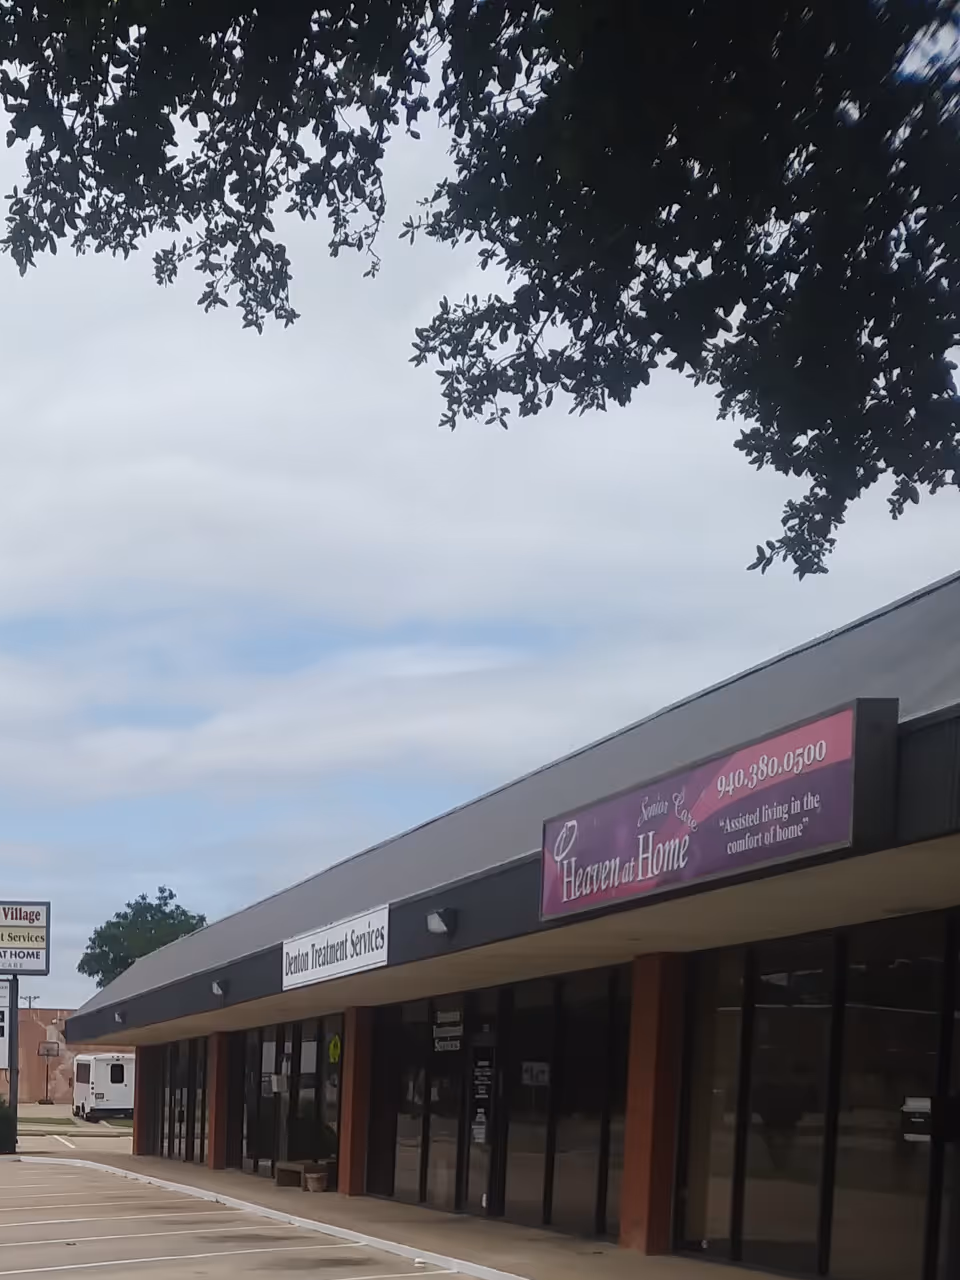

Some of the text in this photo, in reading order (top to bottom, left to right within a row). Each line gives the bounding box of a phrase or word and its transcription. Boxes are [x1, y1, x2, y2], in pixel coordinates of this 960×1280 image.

[717, 740, 827, 799] 940.380.0500
[637, 787, 698, 832] Senior Care
[761, 801, 789, 824] living
[790, 798, 801, 815] in
[803, 792, 820, 810] the
[727, 833, 763, 855] comfort
[764, 829, 775, 846] of
[560, 830, 690, 903] Heaven at Home
[2, 907, 41, 924] Village
[7, 932, 45, 943] Services
[285, 921, 384, 976] Denton Treatment Services
[10, 951, 41, 960] HOME
